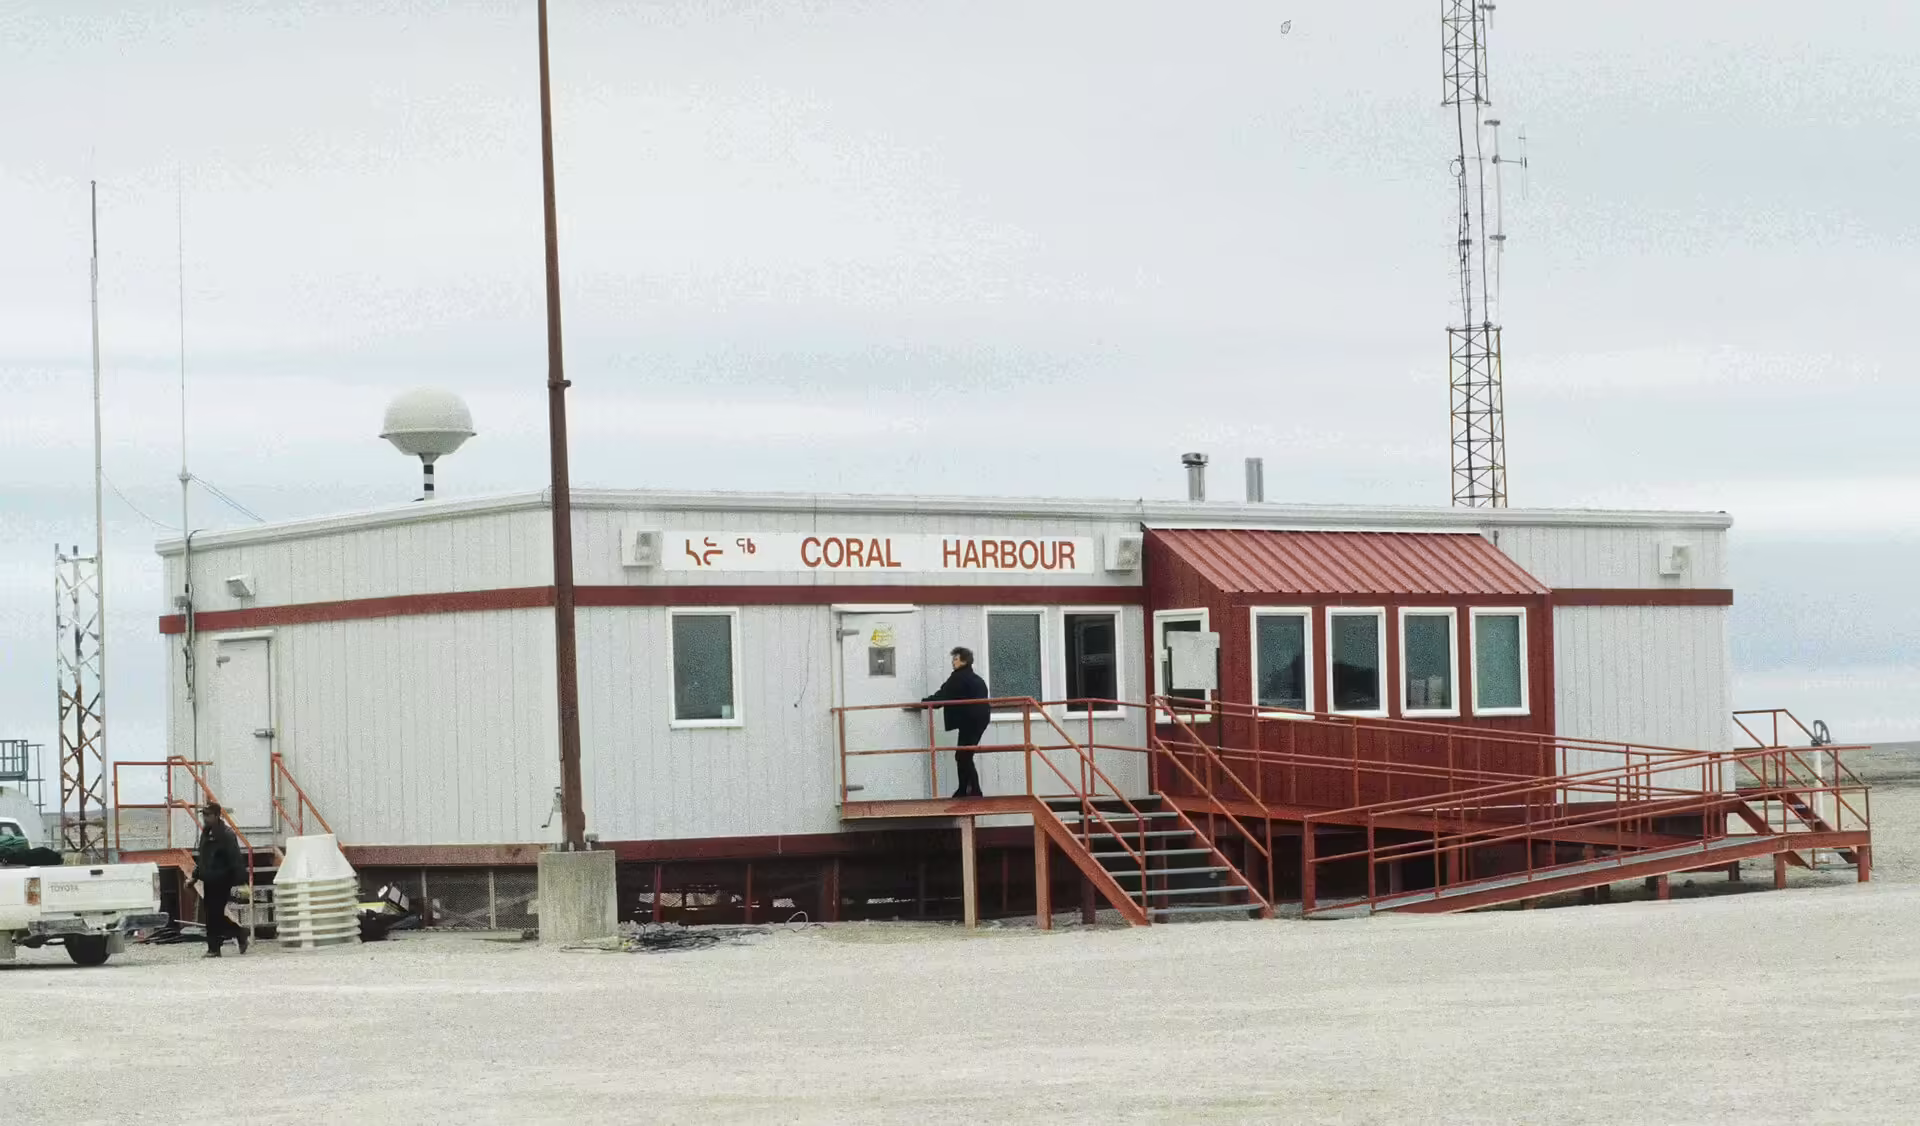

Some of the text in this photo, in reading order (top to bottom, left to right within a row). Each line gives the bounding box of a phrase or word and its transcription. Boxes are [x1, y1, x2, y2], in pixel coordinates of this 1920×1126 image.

[800, 536, 1076, 570] CORAL HARBOUR
[49, 884, 79, 893] TOYOTA
